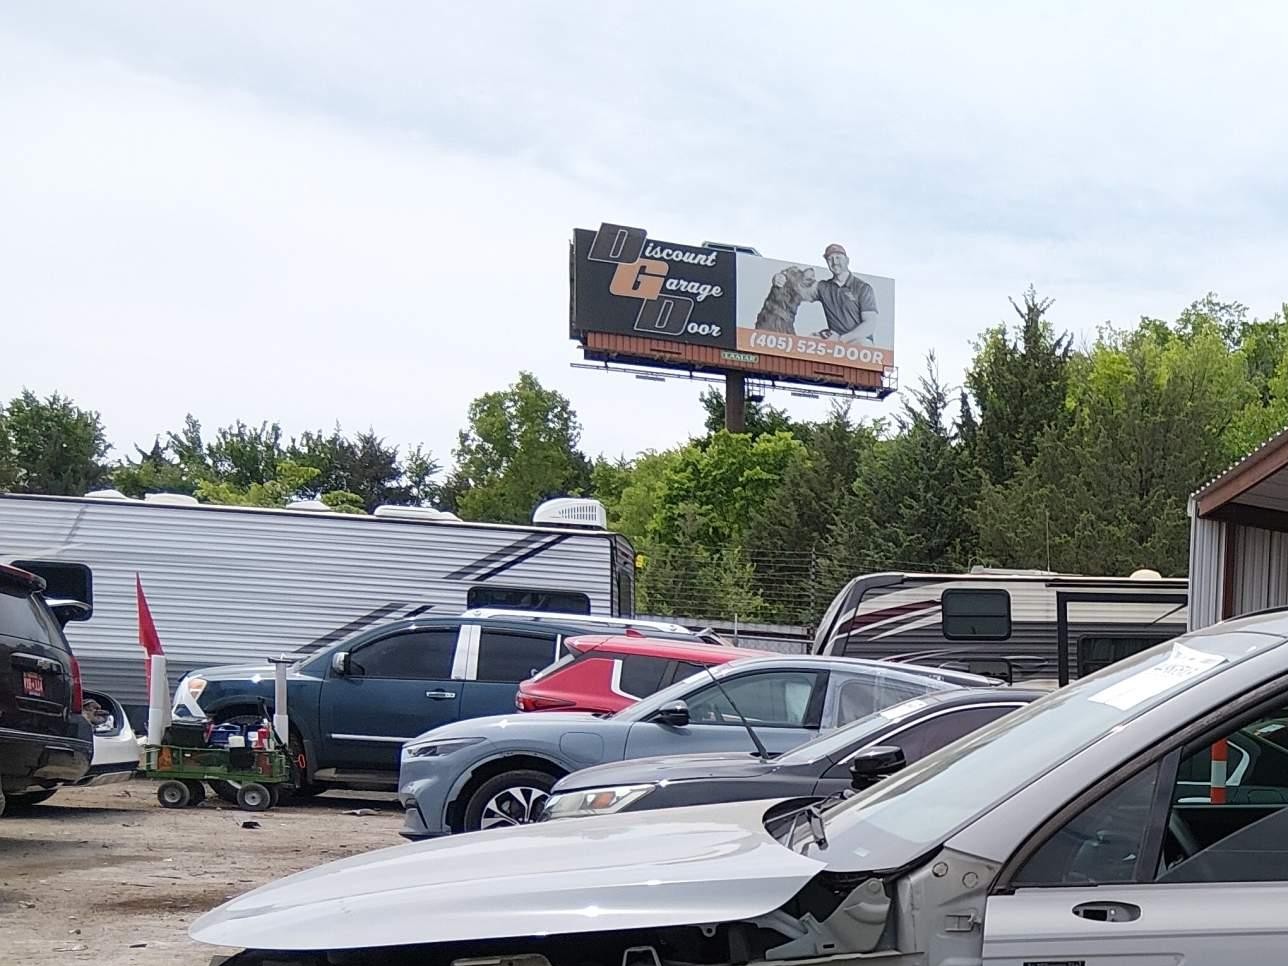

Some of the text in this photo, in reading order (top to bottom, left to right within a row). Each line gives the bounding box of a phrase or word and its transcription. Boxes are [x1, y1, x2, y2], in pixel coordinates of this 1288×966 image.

[587, 222, 717, 266] Discount
[609, 258, 723, 302] Garage
[633, 293, 721, 337] Door
[750, 332, 883, 365] (405) 525-DOOR
